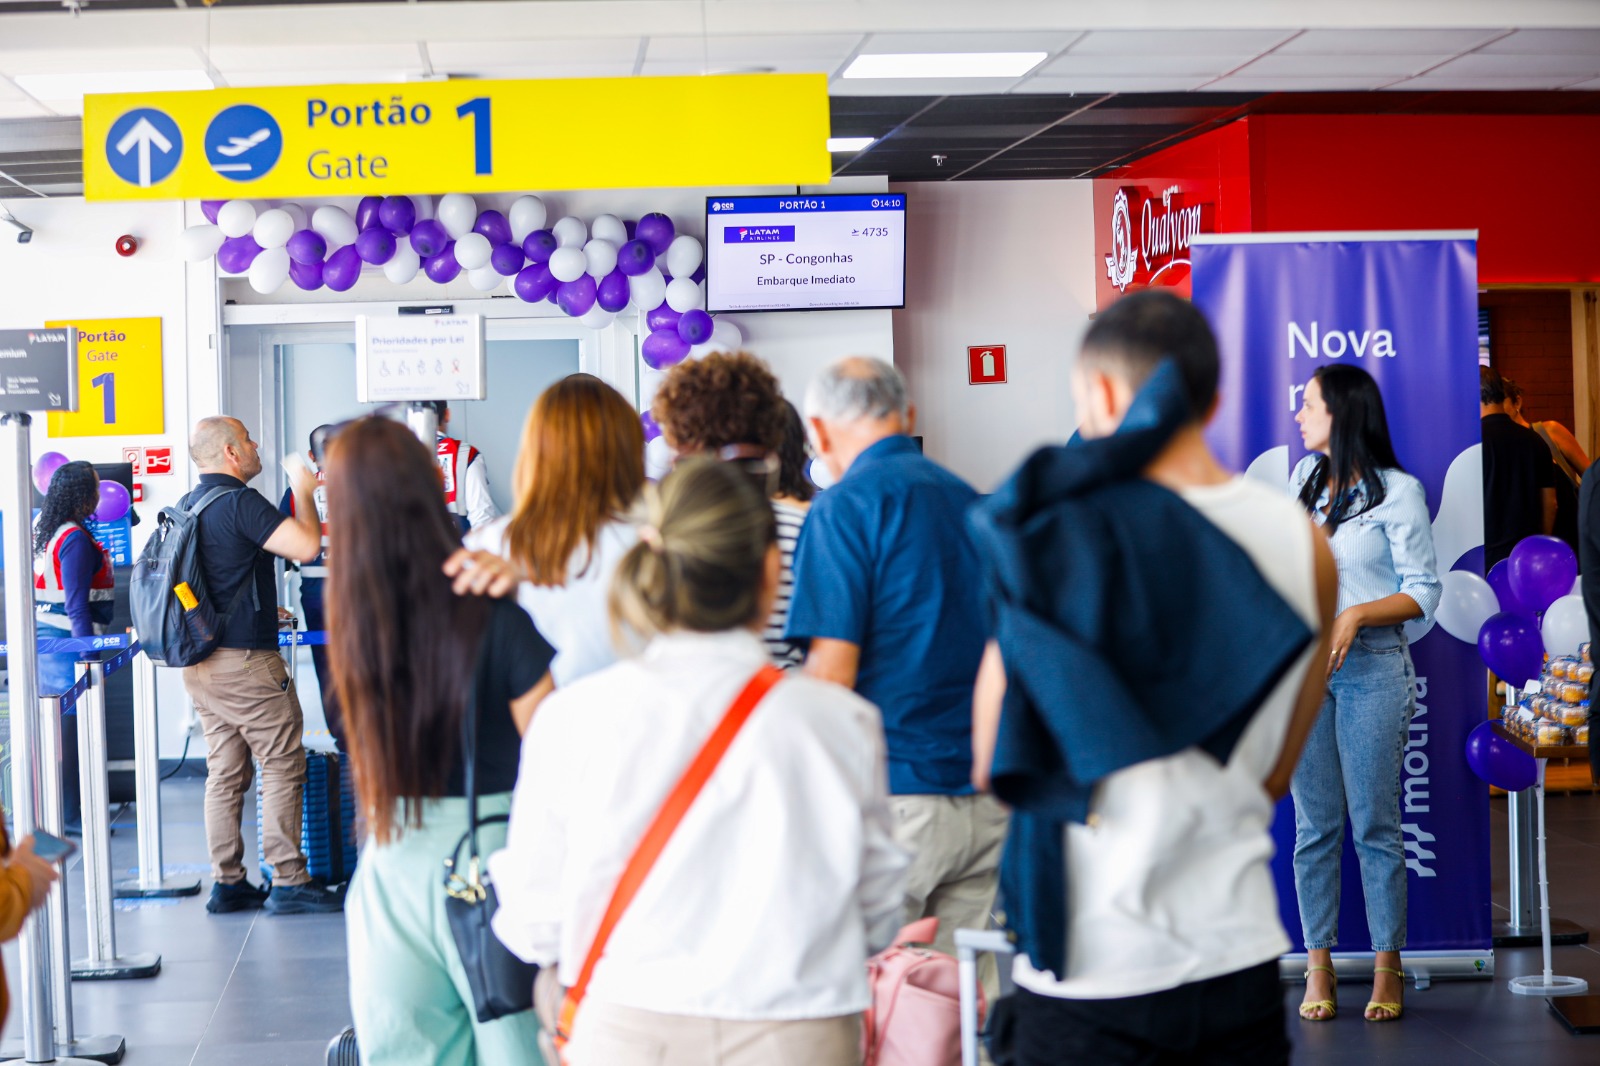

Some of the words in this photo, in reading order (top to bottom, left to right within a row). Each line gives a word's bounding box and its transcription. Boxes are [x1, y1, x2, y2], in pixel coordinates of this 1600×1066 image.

[307, 96, 431, 127] Portão
[456, 97, 493, 176] 1
[307, 150, 388, 180] Gate
[779, 200, 818, 210] PORTÃO
[821, 201, 826, 209] 1
[880, 199, 901, 208] 14:10
[862, 228, 889, 237] 4735
[759, 254, 776, 265] SP
[786, 253, 853, 266] Congonhas
[757, 277, 809, 287] Embarque
[811, 275, 856, 285] Imediato
[36, 333, 66, 343] LATAM
[78, 330, 126, 343] Portão
[372, 337, 428, 346] Prioridades
[431, 337, 447, 346] por
[450, 336, 465, 344] Lei
[1287, 321, 1396, 359] Nova
[87, 350, 118, 362] Gate
[92, 372, 116, 424] 1
